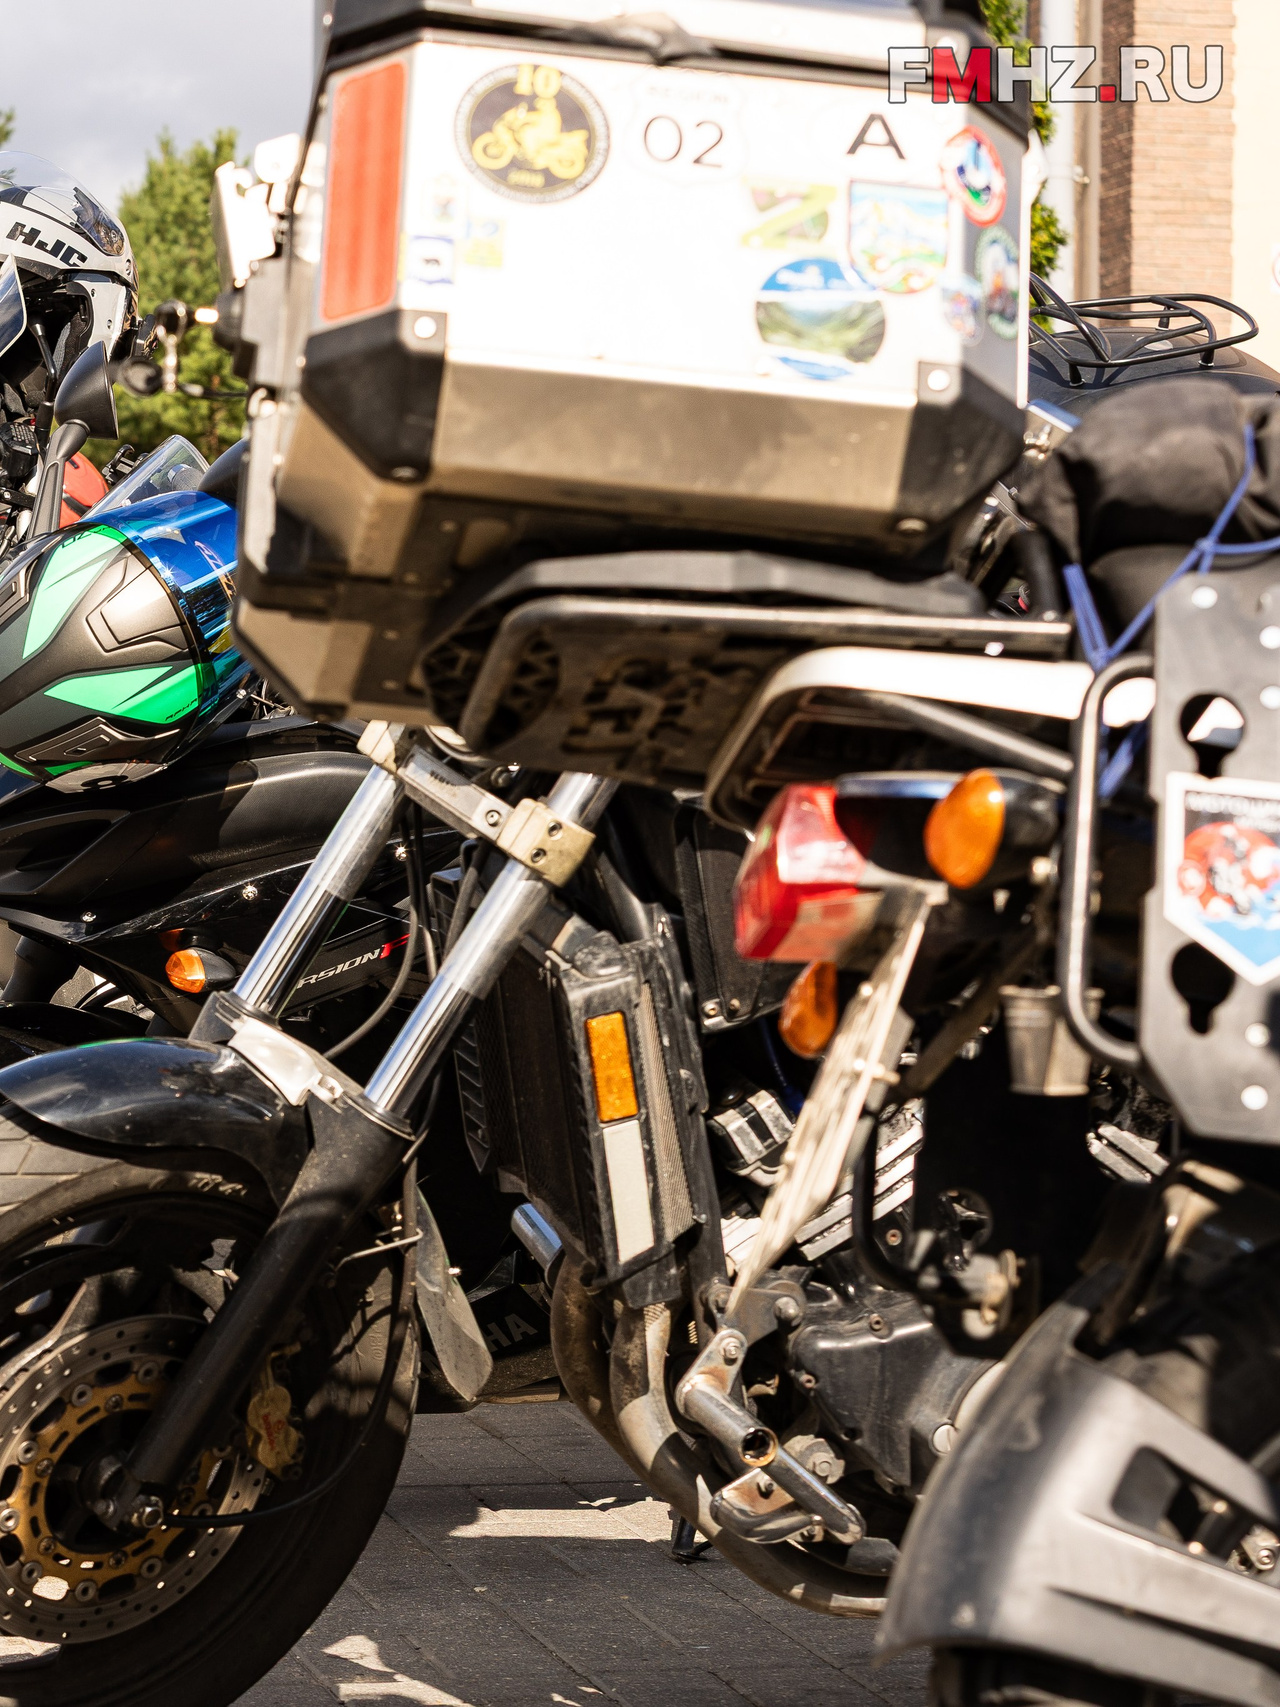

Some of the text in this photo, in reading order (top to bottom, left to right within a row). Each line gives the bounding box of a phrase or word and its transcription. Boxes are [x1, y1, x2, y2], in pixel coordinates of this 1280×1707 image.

[514, 63, 562, 99] 10
[643, 115, 724, 168] 02
[846, 112, 907, 160] A
[5, 220, 89, 268] HJC
